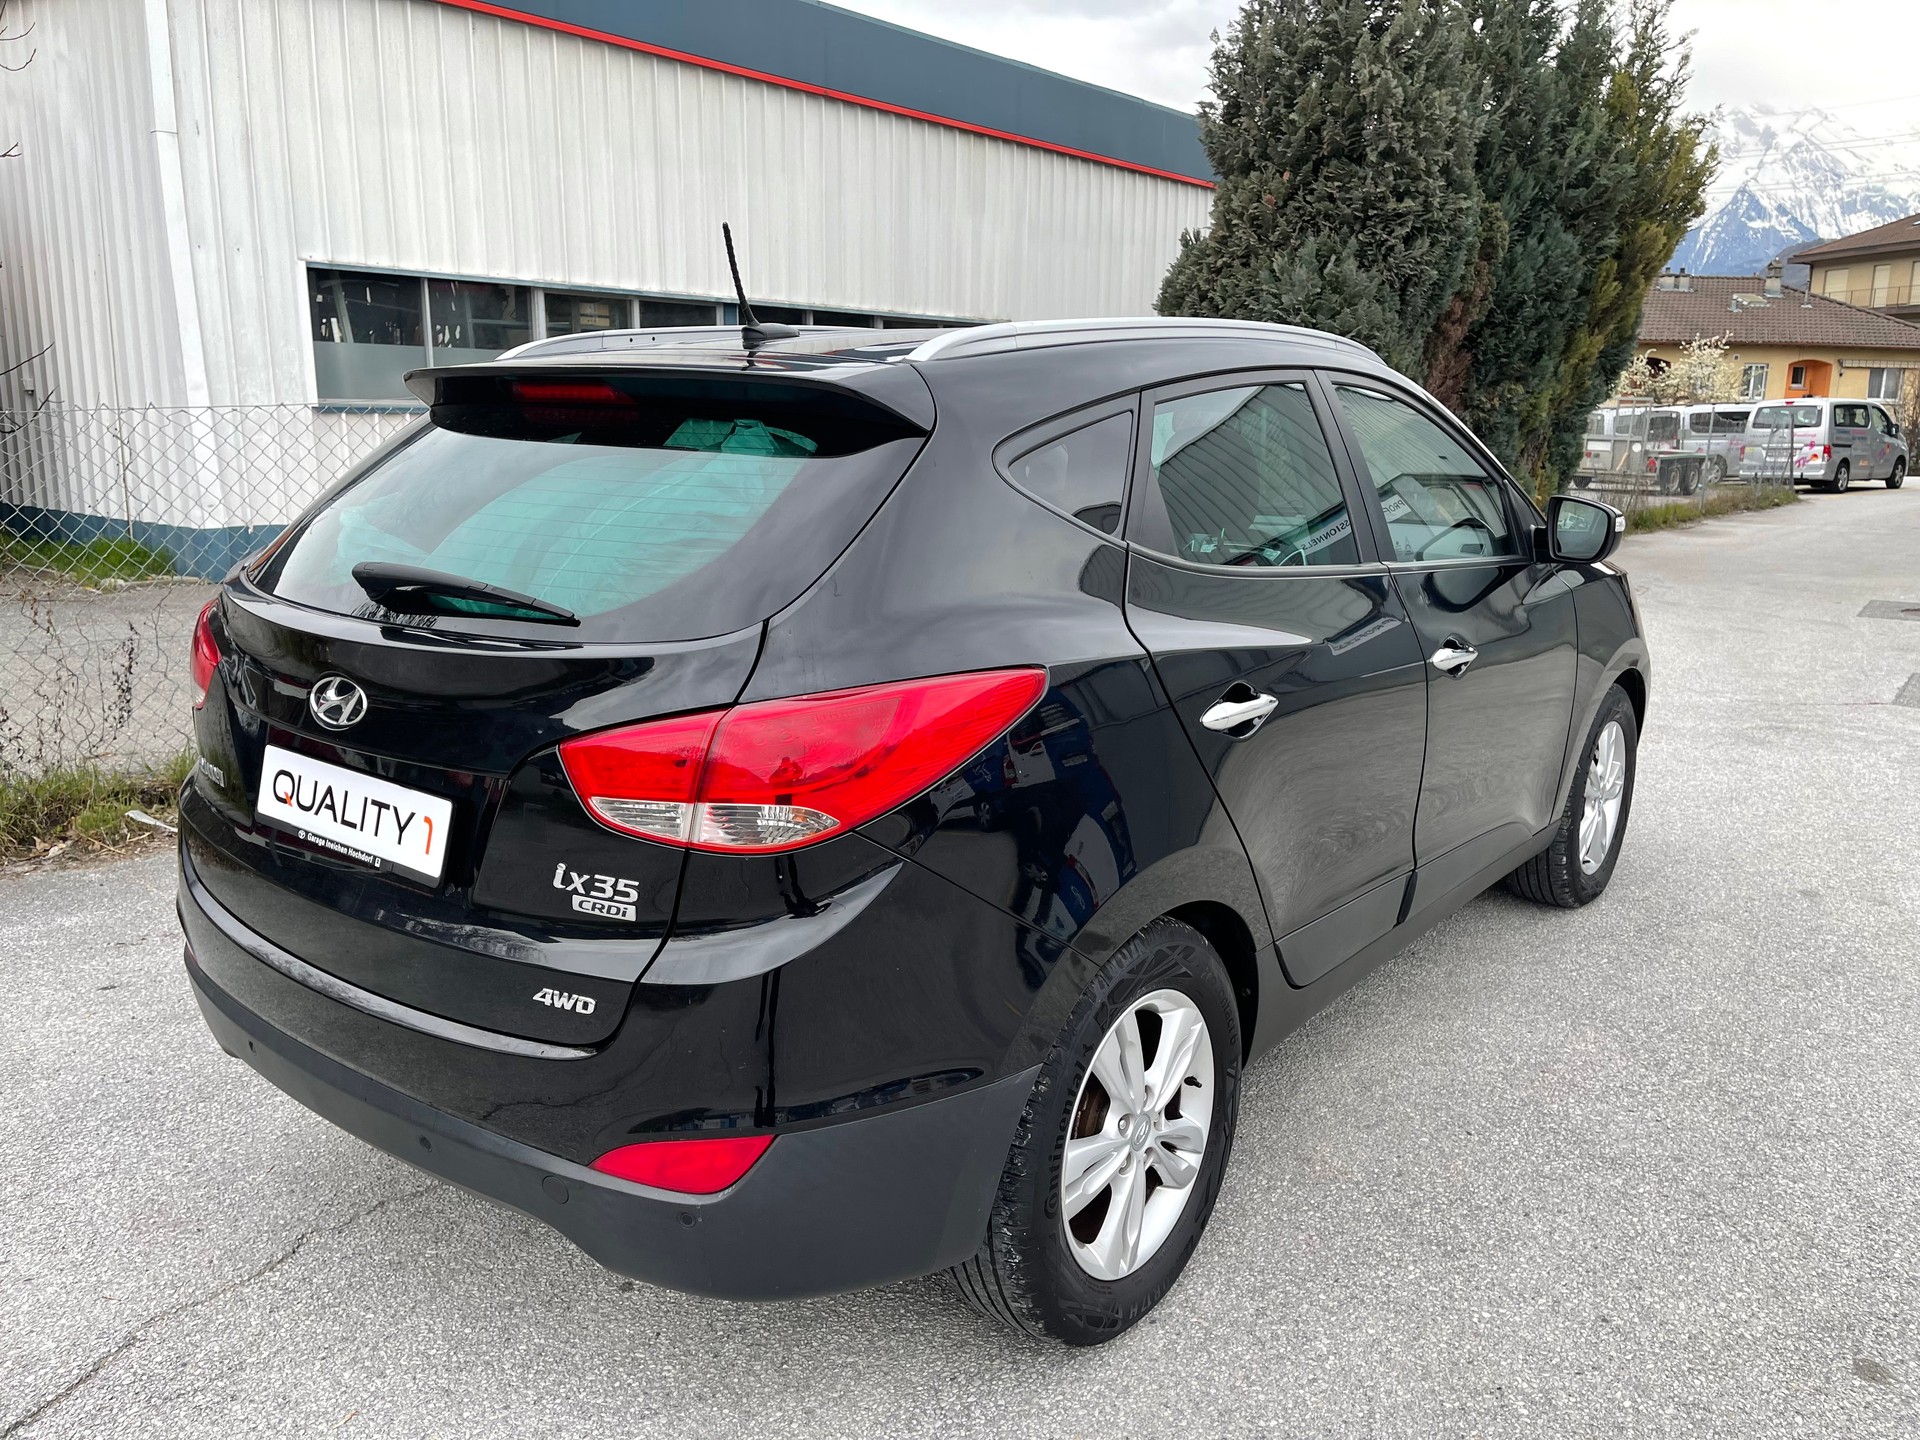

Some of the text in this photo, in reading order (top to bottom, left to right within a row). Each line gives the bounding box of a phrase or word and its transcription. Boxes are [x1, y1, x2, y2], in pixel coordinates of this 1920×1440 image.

[273, 769, 416, 845] QUALITY
[423, 815, 433, 855] 1
[307, 832, 325, 847] Garage
[348, 847, 373, 864] Hochdorf
[552, 862, 640, 903] ix35
[578, 900, 629, 918] CRDi
[532, 987, 597, 1015] 4WD
[1044, 1059, 1088, 1219] Continental
